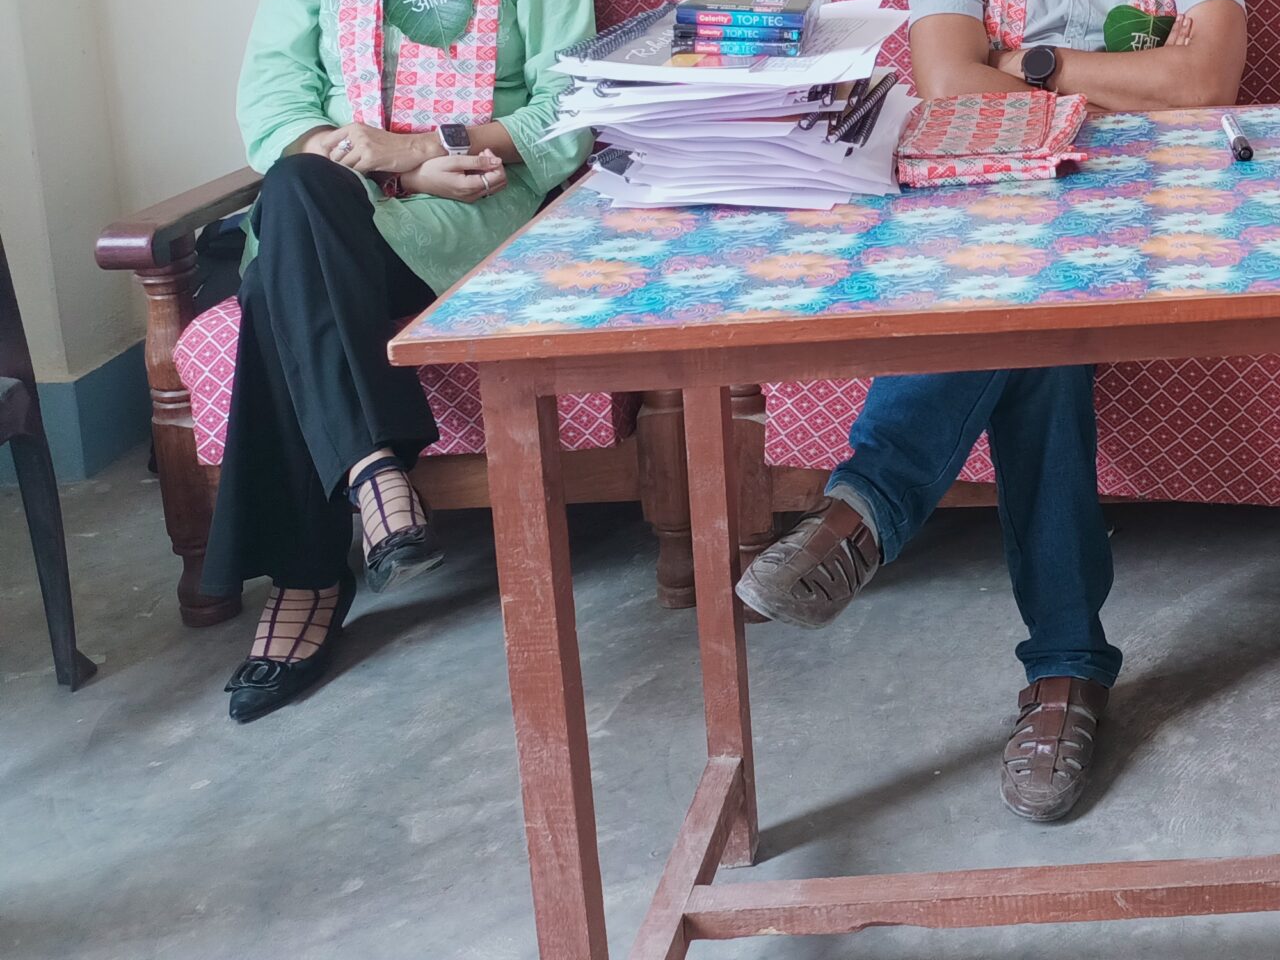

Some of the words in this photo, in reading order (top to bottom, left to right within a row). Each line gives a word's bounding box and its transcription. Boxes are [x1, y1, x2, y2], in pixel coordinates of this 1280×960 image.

[736, 14, 760, 26] TOP
[763, 15, 784, 27] TEC
[725, 29, 743, 38] TOP
[745, 30, 760, 38] TEC
